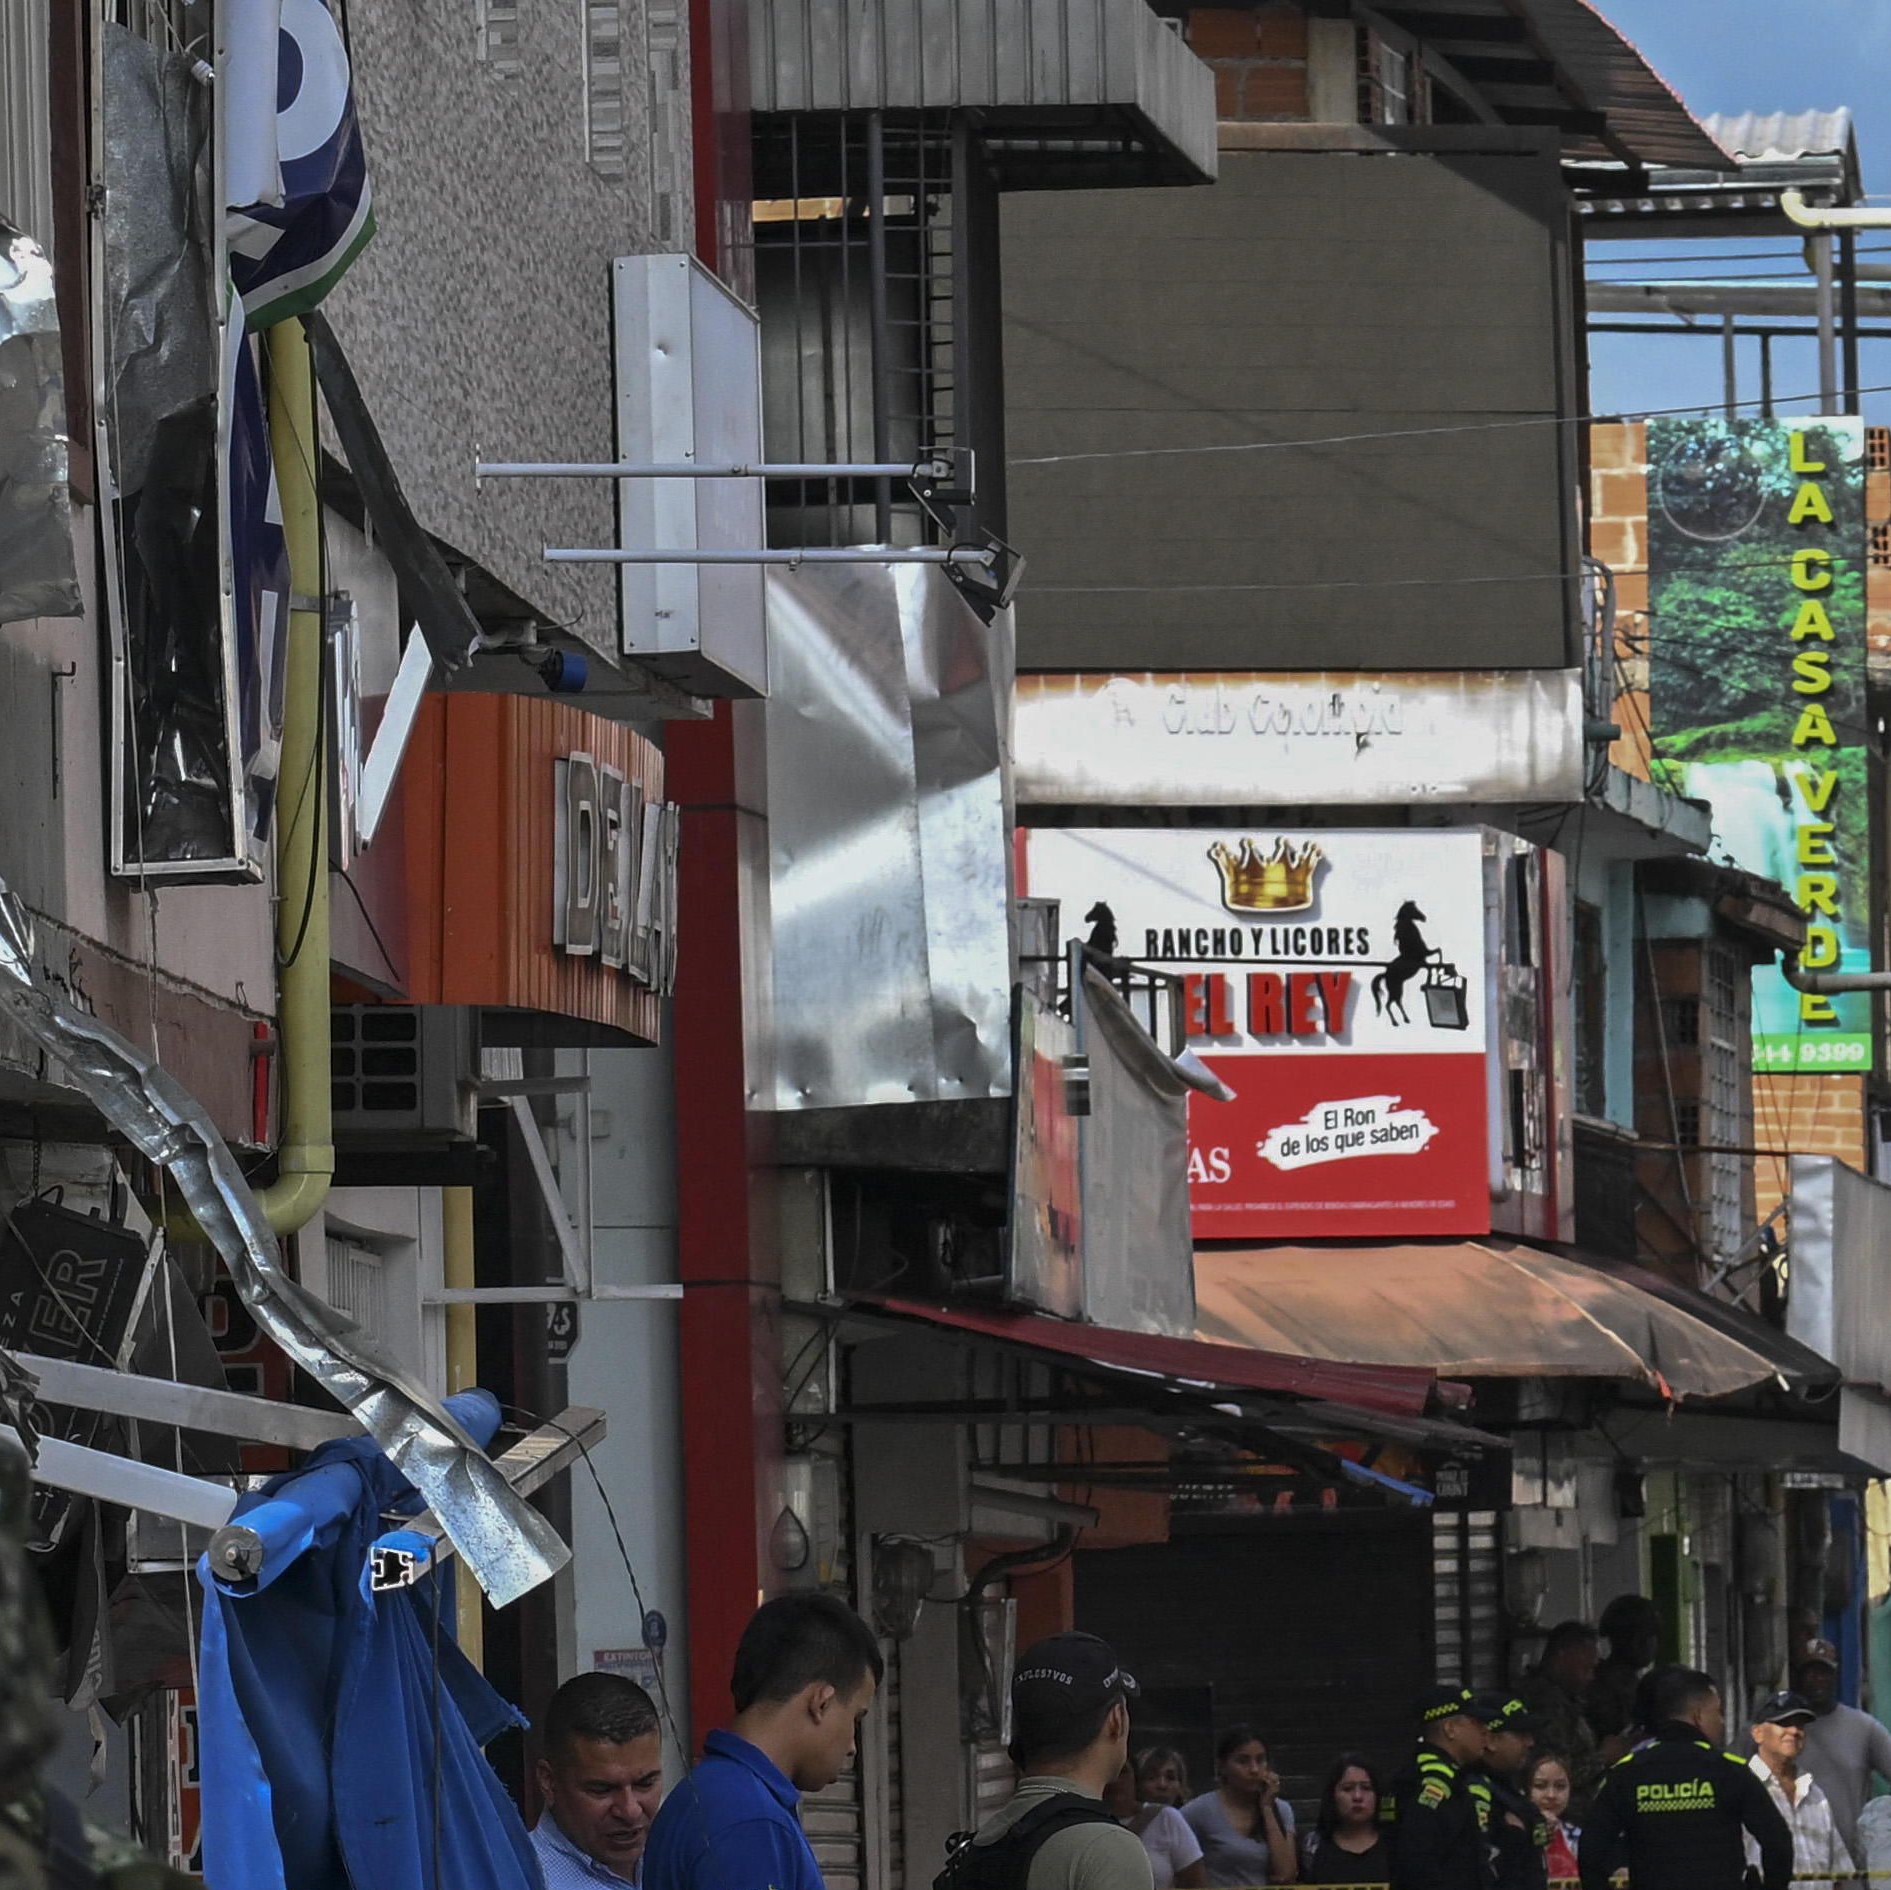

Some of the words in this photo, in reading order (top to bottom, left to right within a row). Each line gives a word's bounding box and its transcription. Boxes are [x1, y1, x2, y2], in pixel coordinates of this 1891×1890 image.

[1787, 432, 1832, 524] LA
[1791, 549, 1836, 747] CASA
[1794, 769, 1839, 1024] VERDE
[1145, 927, 1244, 958] RANCHO
[1251, 927, 1264, 956] Y
[1270, 926, 1371, 957] LICORES
[1182, 972, 1236, 1036] EL
[1246, 971, 1353, 1036] REY
[1280, 1136, 1301, 1158] de
[1305, 1134, 1330, 1154] los
[1334, 1132, 1366, 1154] que
[1369, 1122, 1420, 1146] saben
[1323, 1109, 1339, 1131] El
[1343, 1107, 1376, 1128] Ron
[1635, 1778, 1715, 1801] POLICÍA
